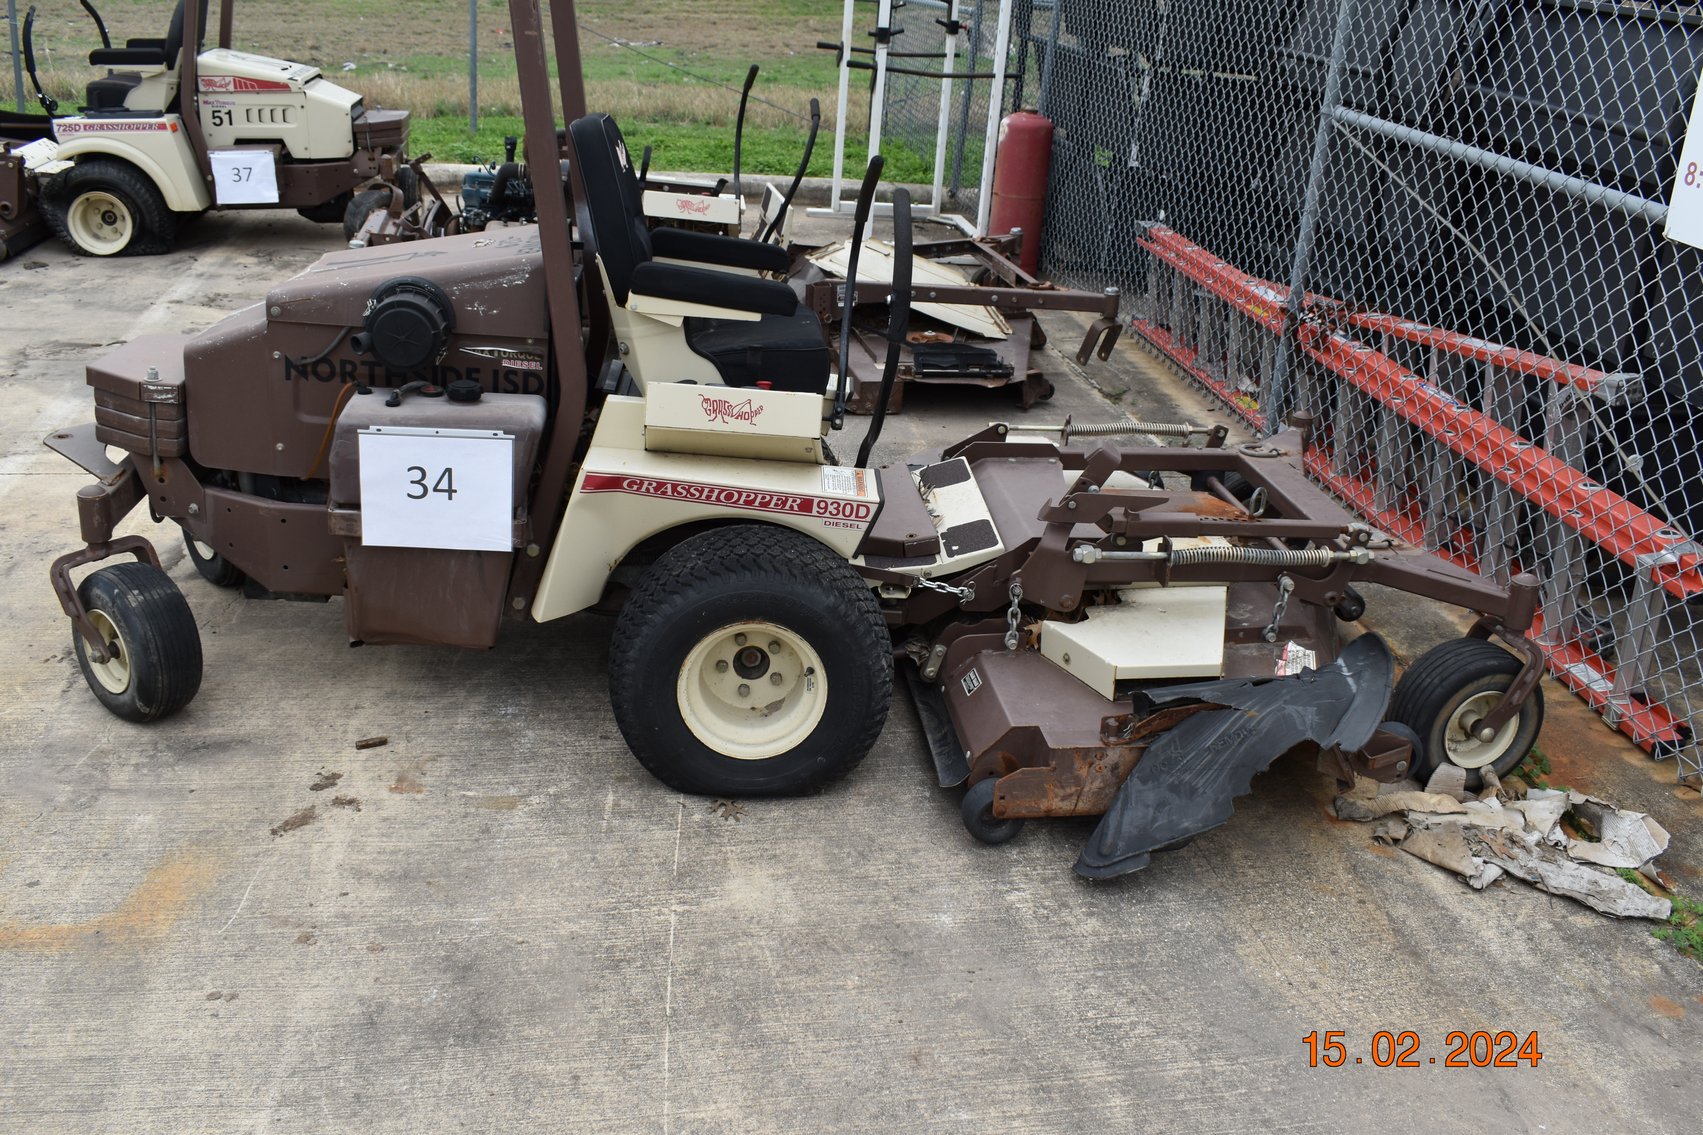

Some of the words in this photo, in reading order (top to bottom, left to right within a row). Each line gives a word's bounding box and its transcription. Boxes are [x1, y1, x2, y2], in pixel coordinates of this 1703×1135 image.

[212, 109, 233, 127] 51
[56, 123, 81, 132] 725D
[86, 122, 159, 131] GRASSHOPPER
[232, 167, 253, 182] 37
[502, 359, 543, 370] DIESEL
[492, 368, 545, 395] ISD
[406, 465, 458, 501] 34
[622, 478, 802, 511] GRASSHOPPER
[816, 499, 871, 519] 930D
[823, 520, 862, 529] DIESEL
